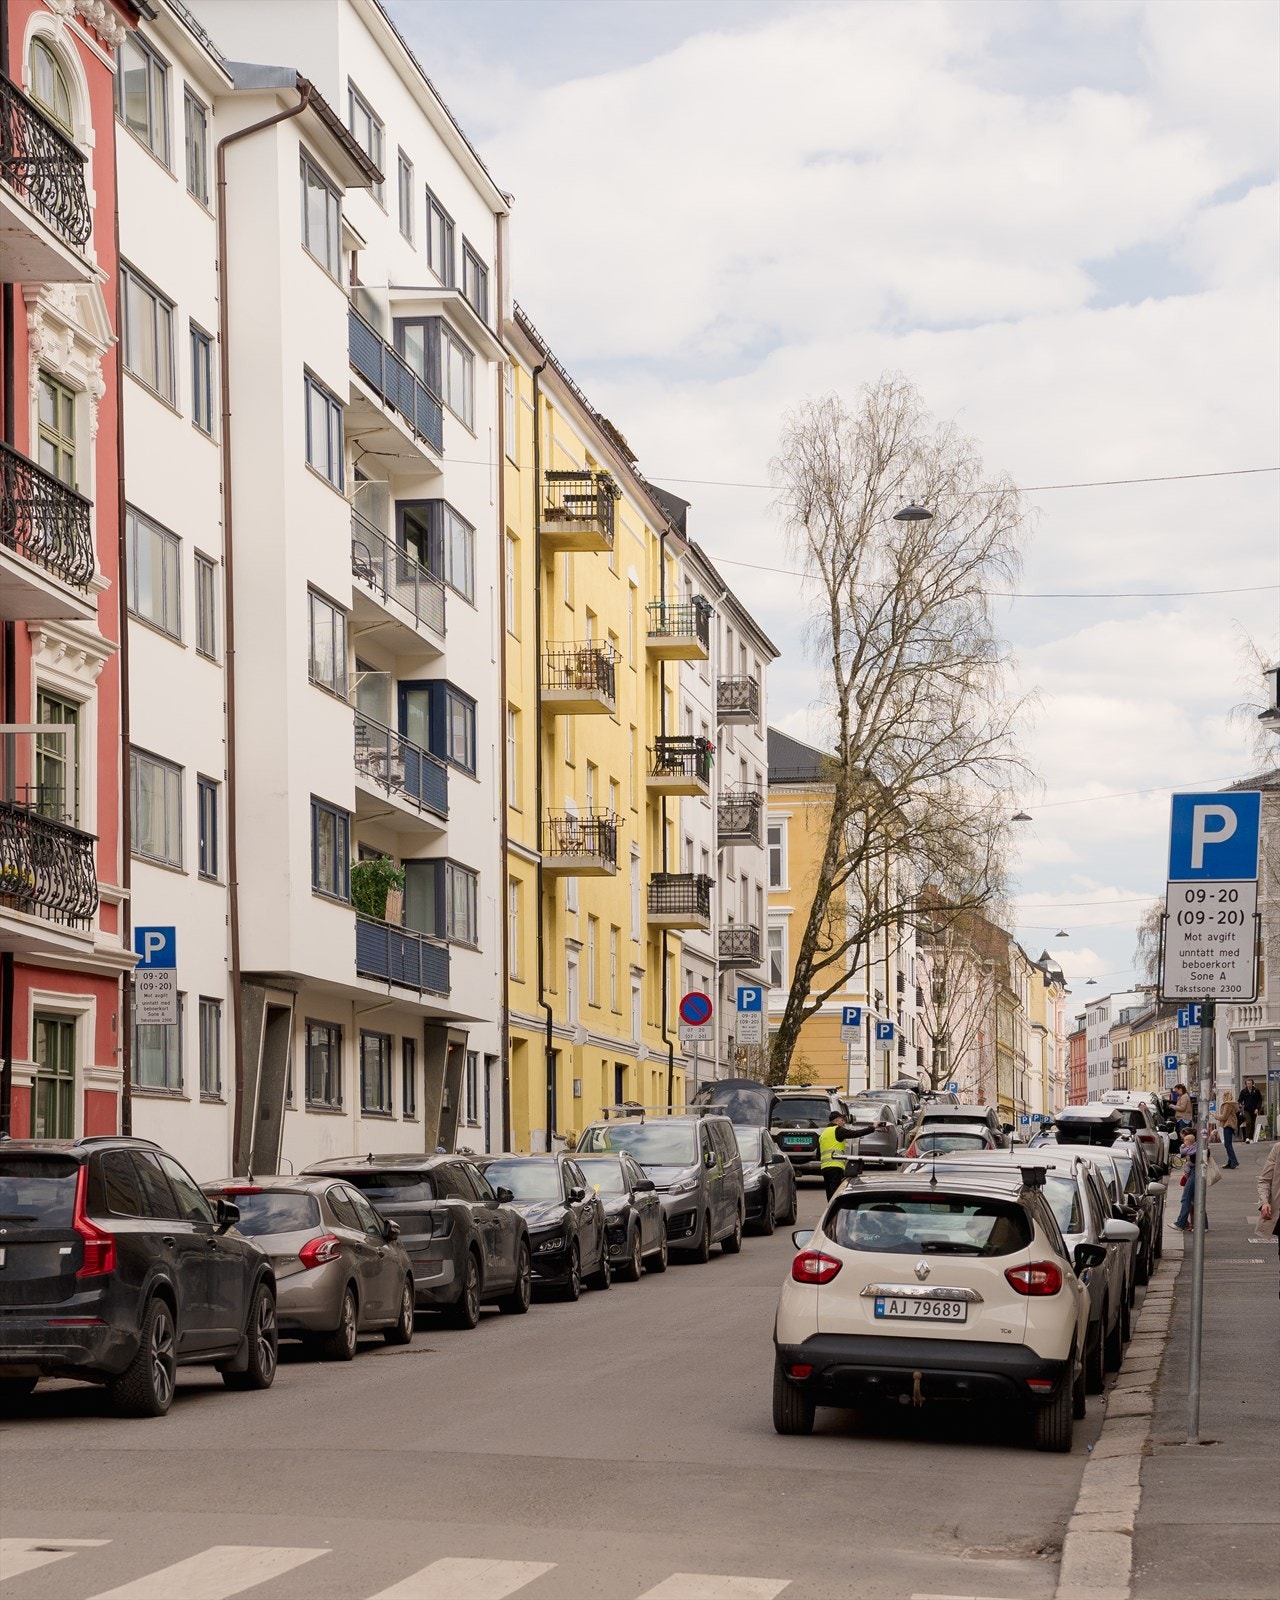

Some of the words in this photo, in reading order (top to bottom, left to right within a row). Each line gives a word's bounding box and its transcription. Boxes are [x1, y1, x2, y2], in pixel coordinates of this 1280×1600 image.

[1190, 804, 1238, 869] P
[1184, 888, 1239, 904] 09-20
[1177, 909, 1245, 927] (09-20)
[1184, 932, 1202, 942] Mot
[1207, 932, 1236, 944] avgift
[144, 931, 166, 963] P
[1179, 948, 1214, 957] unntatt
[1219, 948, 1240, 957] med
[1182, 959, 1236, 969] beboerkort
[1190, 971, 1215, 981] Sone
[1219, 971, 1227, 981] A
[1175, 984, 1216, 993] Takstsone
[1220, 984, 1242, 993] 2300
[742, 990, 756, 1009] P
[846, 1008, 857, 1024] P
[880, 1025, 890, 1038] P
[1167, 1057, 1175, 1068] P
[949, 1083, 956, 1091] P
[1022, 1116, 1028, 1124] P
[889, 1300, 907, 1314] AJ
[913, 1301, 961, 1317] 79689
